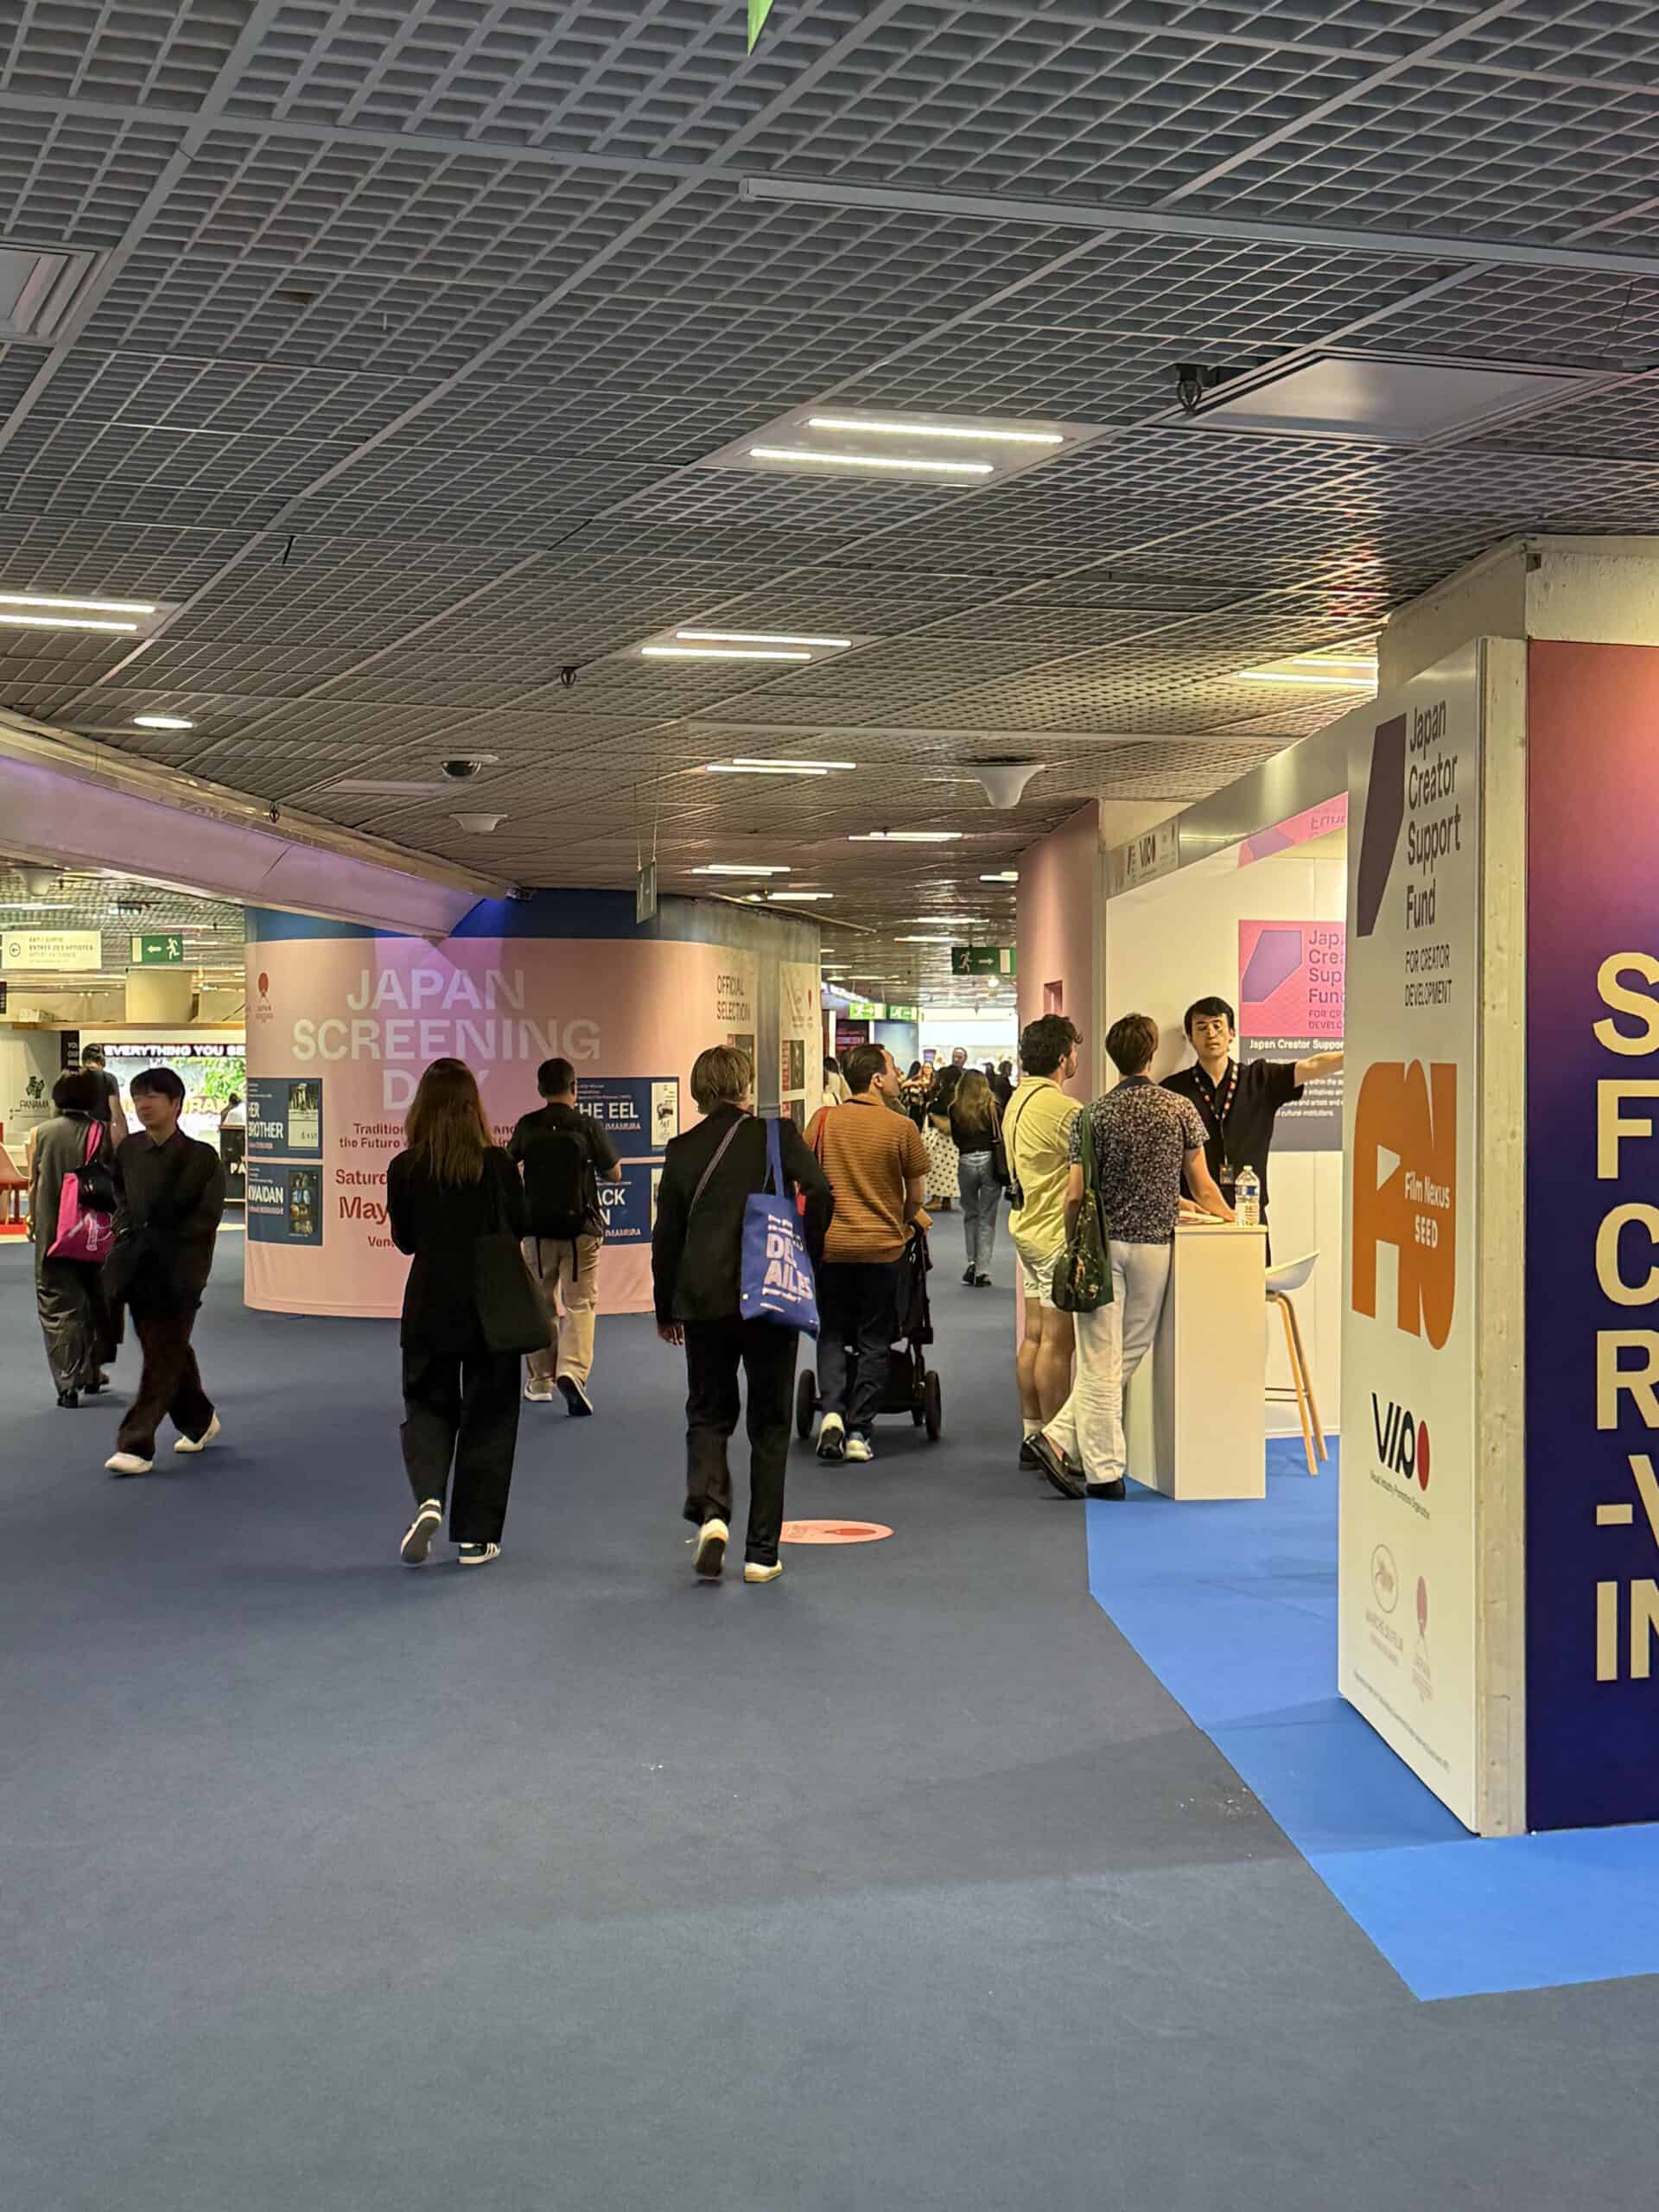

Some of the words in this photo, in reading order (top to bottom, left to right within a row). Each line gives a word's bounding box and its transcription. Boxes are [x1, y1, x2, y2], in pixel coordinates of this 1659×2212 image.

[1410, 699, 1446, 760] Japan
[1408, 753, 1458, 810] Creator
[1408, 803, 1461, 875] Support
[1406, 878, 1436, 930] Fund
[1309, 930, 1344, 950] Jap
[1309, 949, 1344, 964] Cre
[1405, 950, 1419, 973] FOR
[1420, 944, 1450, 971] CREATOR
[347, 969, 524, 1010] JAPAN
[716, 975, 745, 996] OFFICIAL
[1405, 980, 1452, 1007] DEVELOPMENT
[716, 1001, 750, 1021] SELECTION
[104, 1045, 191, 1056] EVERYTHING
[194, 1045, 224, 1056] YOU
[292, 1019, 601, 1061] SCREENING
[1249, 1039, 1276, 1050] Japan
[1278, 1039, 1311, 1049] Creator
[608, 1102, 639, 1119] EEL
[340, 1137, 358, 1148] the
[361, 1137, 400, 1148] Future
[1597, 1079, 1659, 1179] F
[1404, 1171, 1424, 1205] Film
[1424, 1174, 1451, 1210] Nexus
[340, 1196, 388, 1225] May
[1414, 1214, 1439, 1249] SEED
[1595, 1202, 1659, 1306] C
[1597, 1329, 1659, 1430] R
